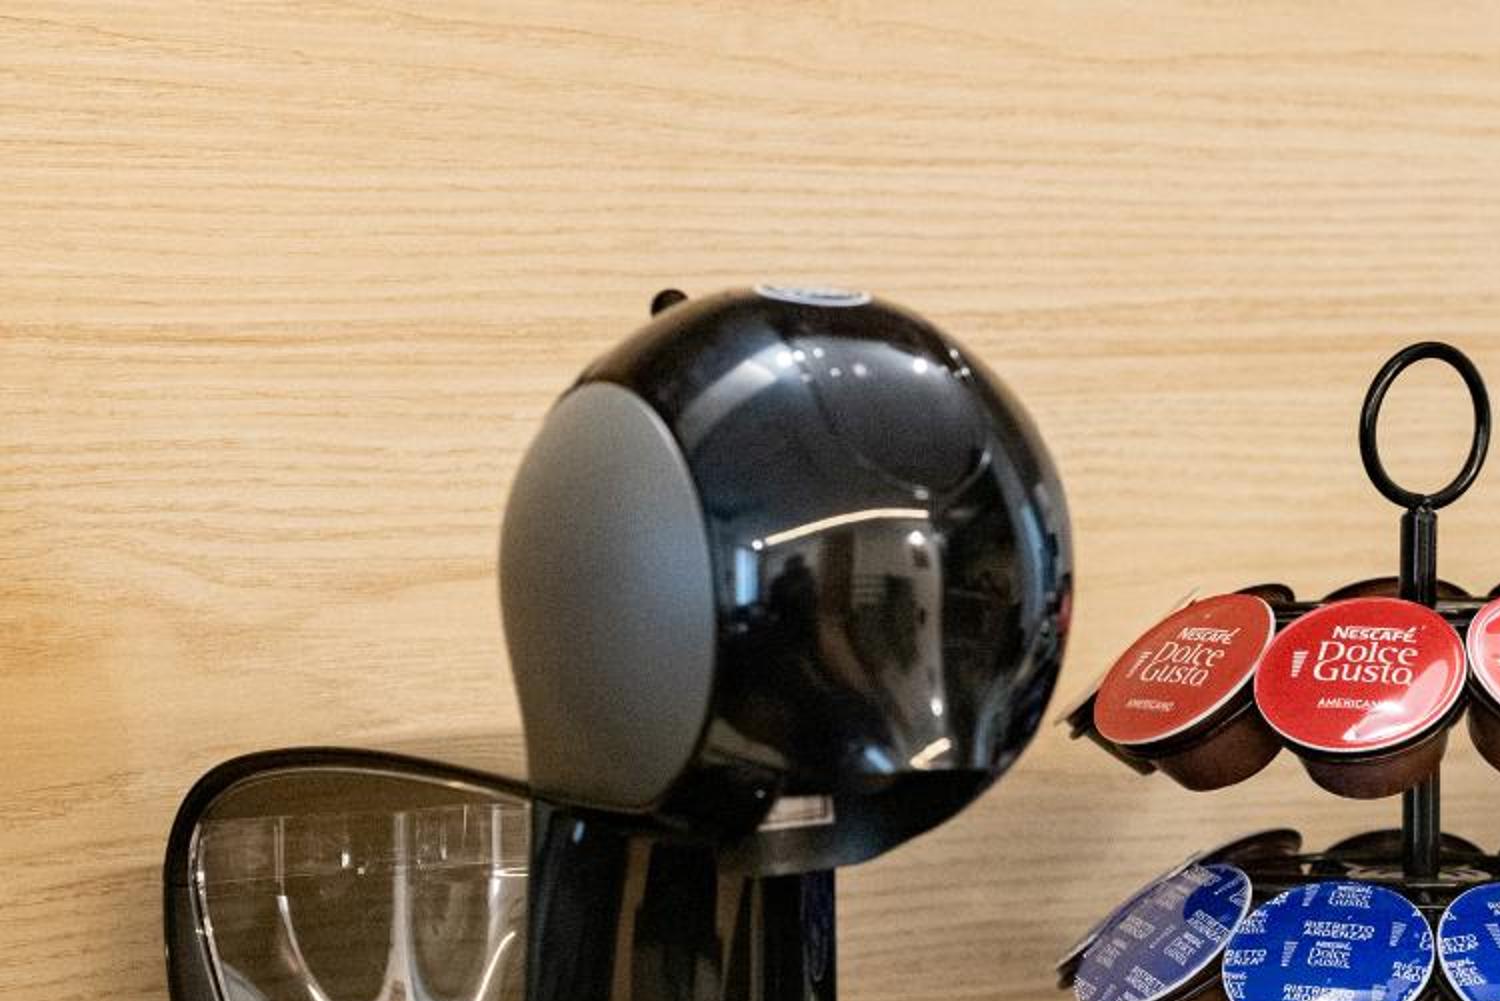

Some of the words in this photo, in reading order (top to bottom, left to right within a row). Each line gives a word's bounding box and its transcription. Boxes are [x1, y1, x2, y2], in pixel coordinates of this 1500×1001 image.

[1332, 625, 1417, 643] NESCAFÉ
[1151, 641, 1225, 667] Dolce
[1318, 640, 1419, 666] Dolce
[1141, 660, 1209, 687] Gusto
[1313, 660, 1414, 686] Gusto
[1317, 697, 1392, 710] AMERICAN
